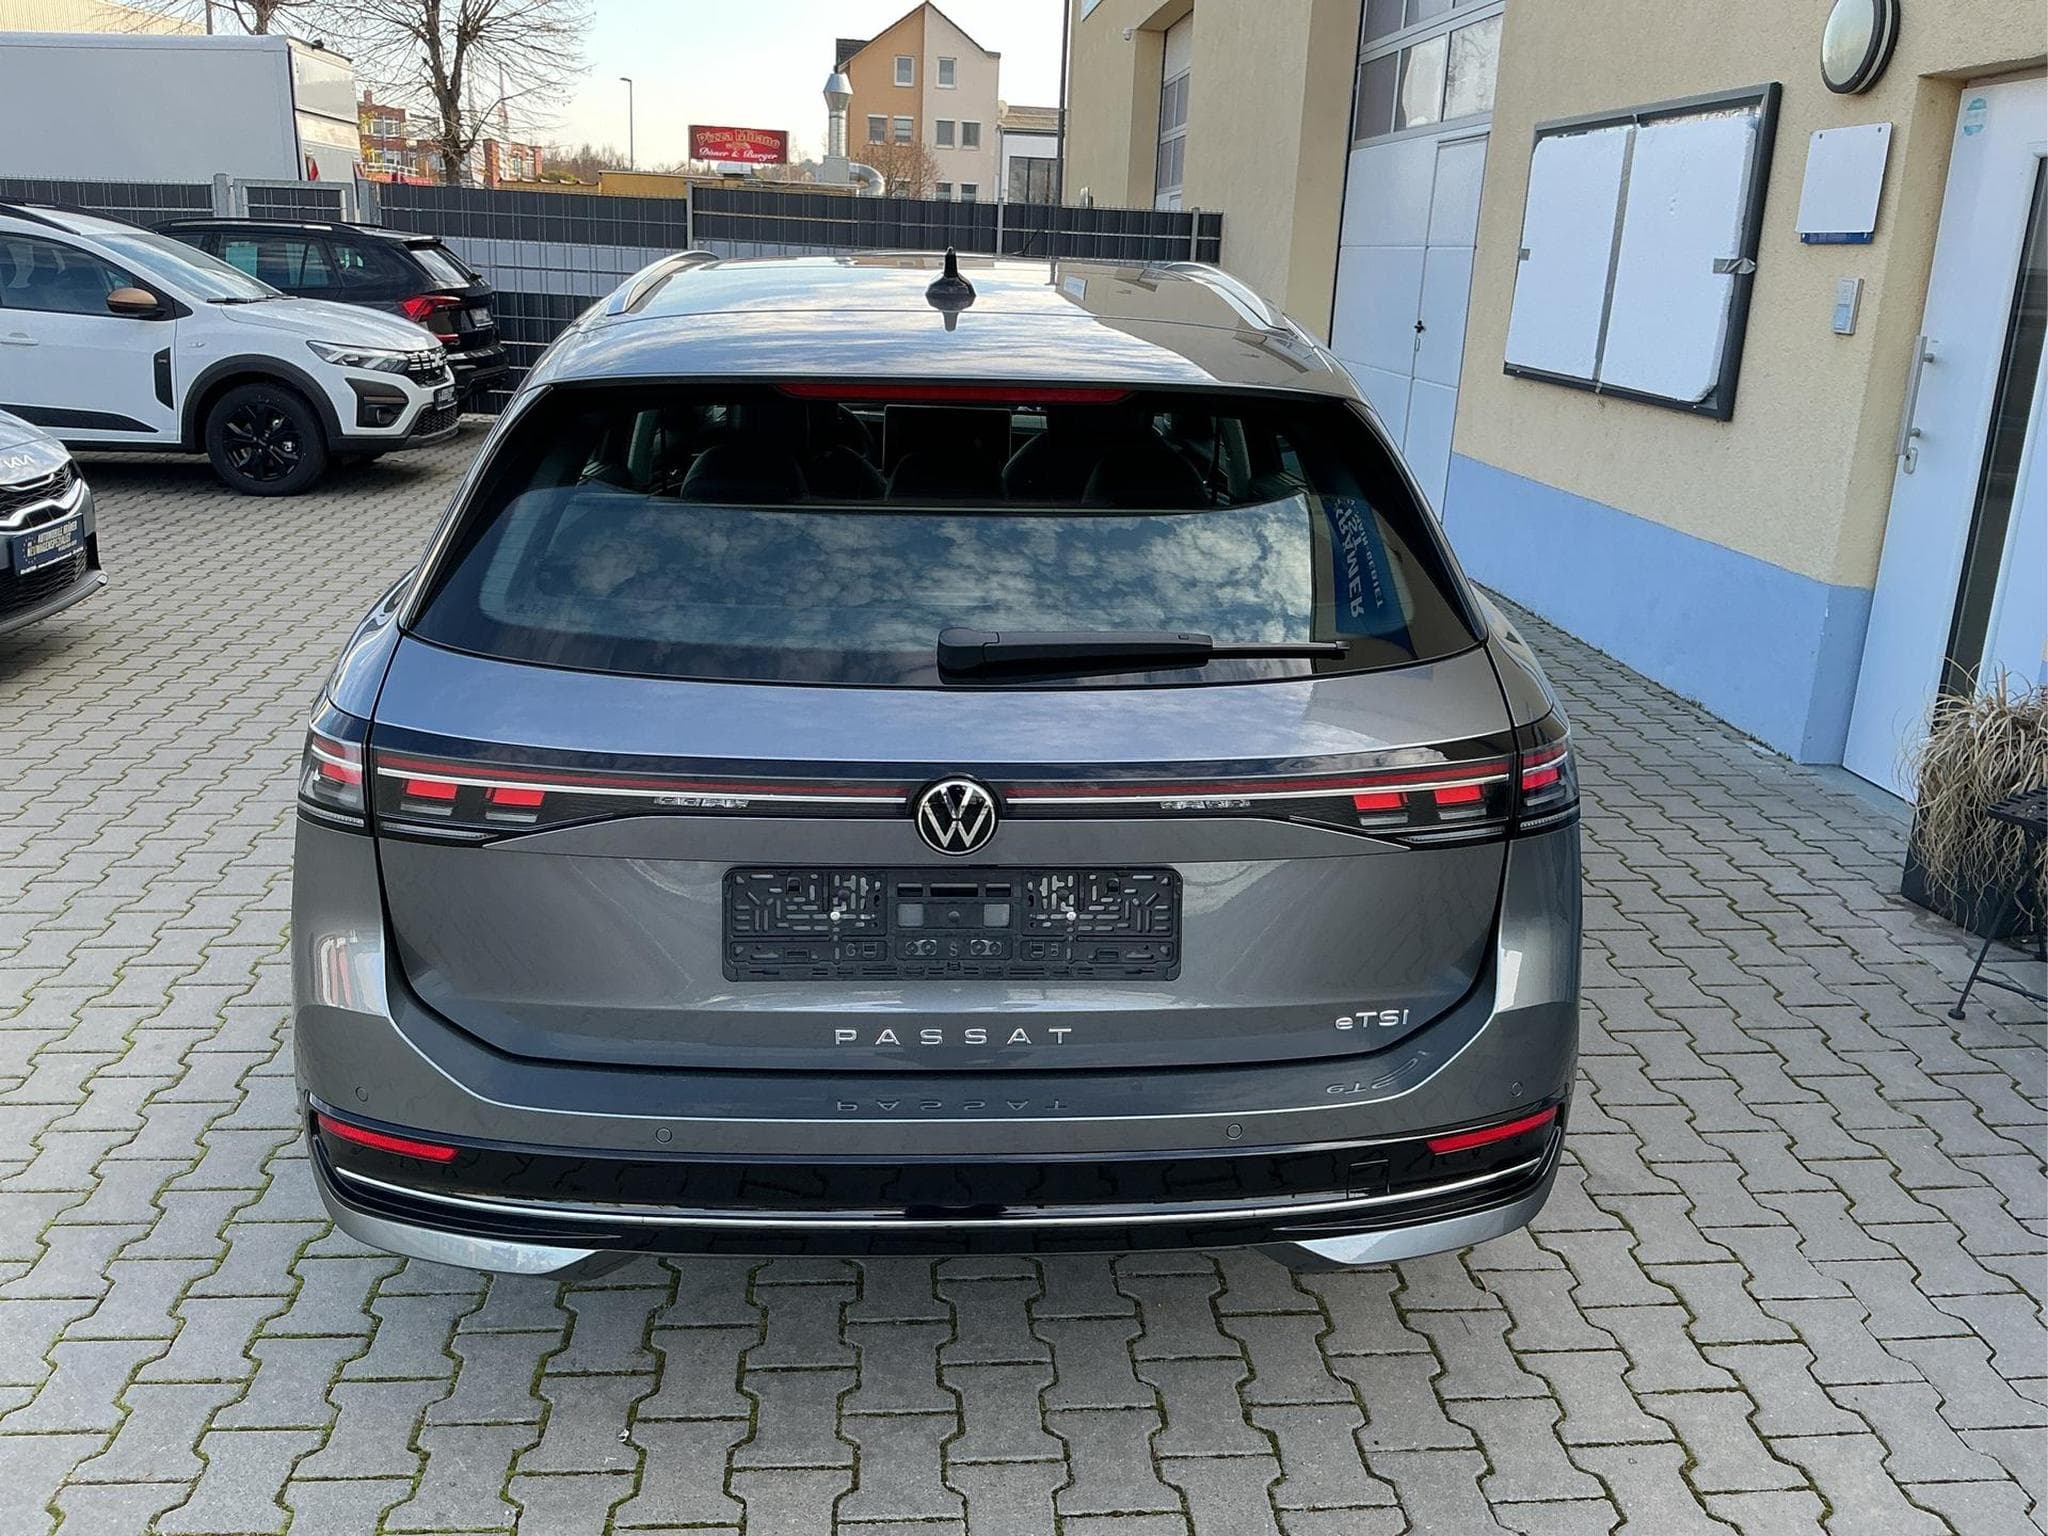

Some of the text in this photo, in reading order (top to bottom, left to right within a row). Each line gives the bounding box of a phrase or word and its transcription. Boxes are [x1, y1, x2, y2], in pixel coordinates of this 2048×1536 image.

[696, 129, 780, 149] Pizza Milano
[699, 147, 729, 157] Döner
[743, 149, 778, 162] Burger
[919, 782, 994, 852] VW
[1335, 1009, 1410, 1031] eTSI
[834, 1027, 1073, 1046] PASSAT
